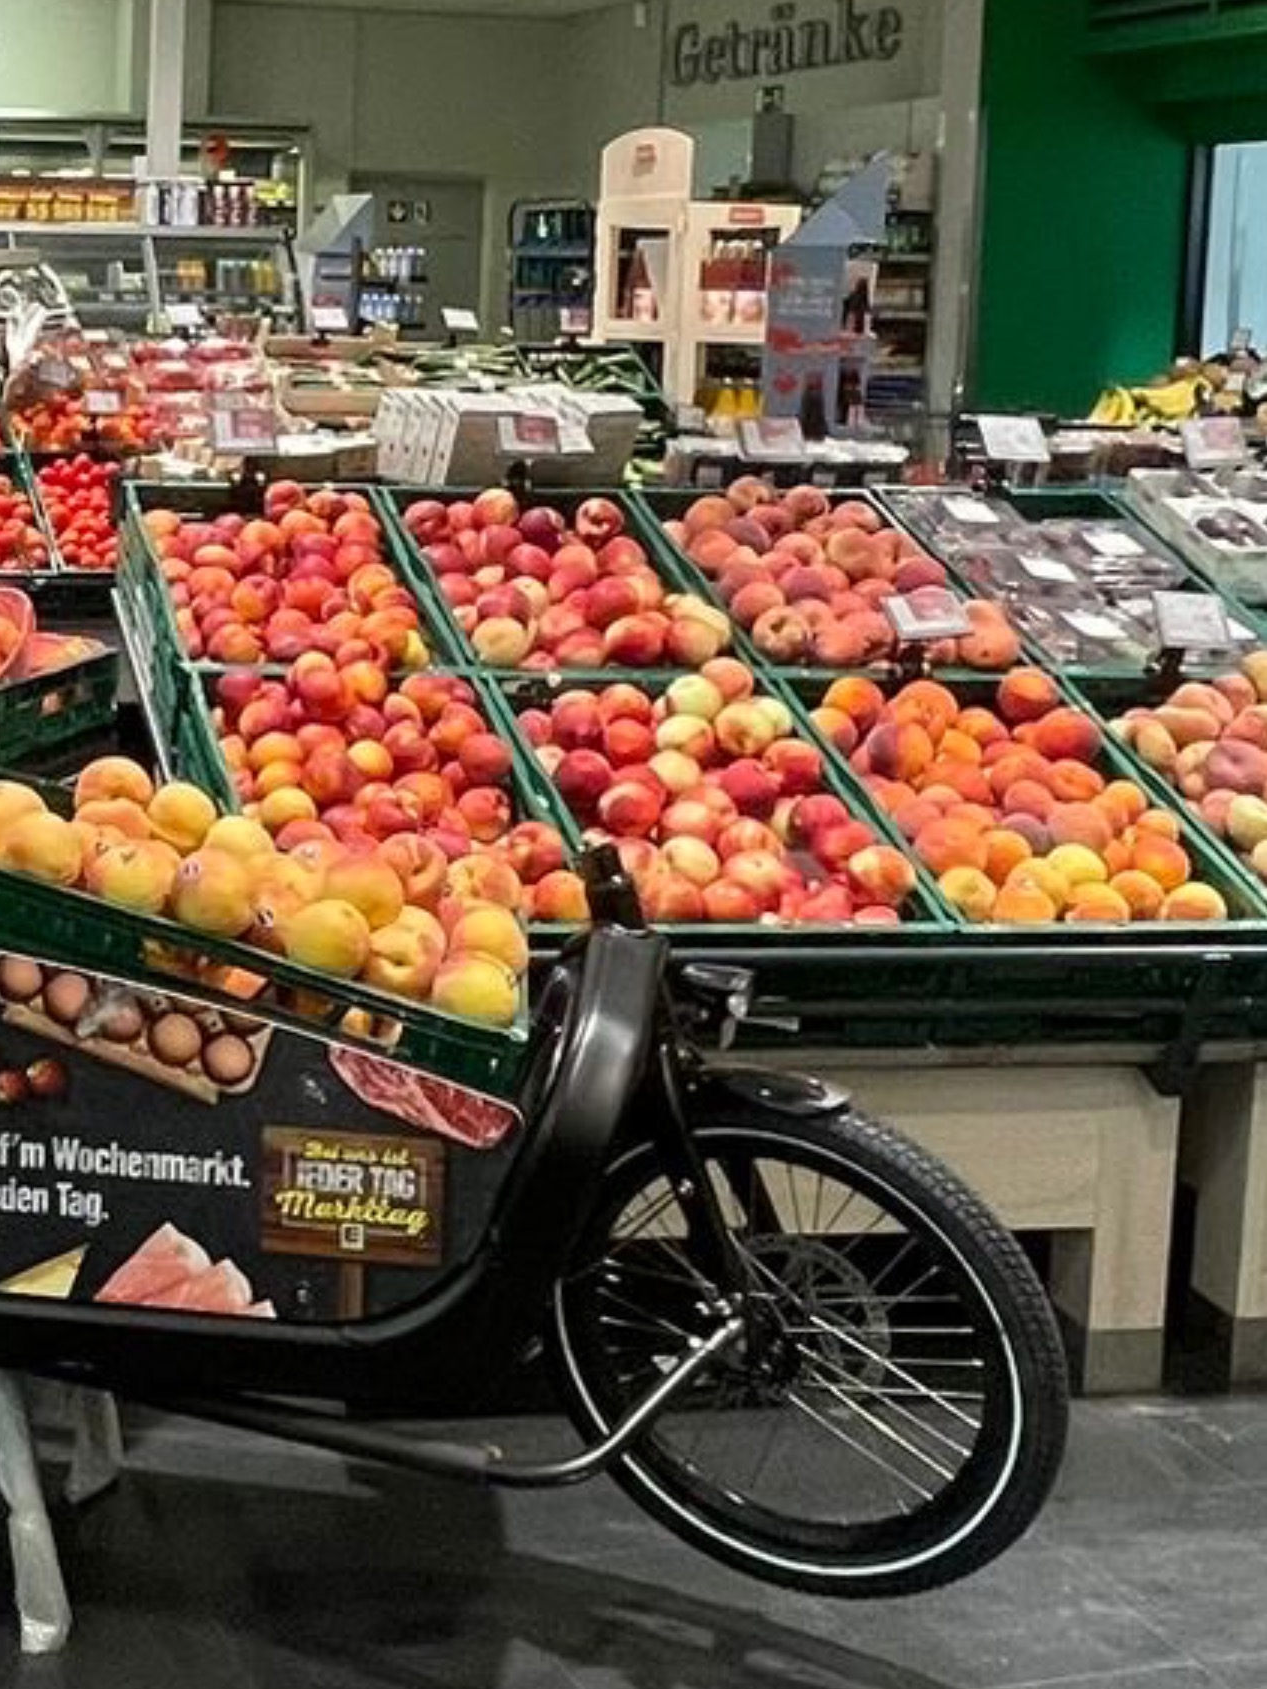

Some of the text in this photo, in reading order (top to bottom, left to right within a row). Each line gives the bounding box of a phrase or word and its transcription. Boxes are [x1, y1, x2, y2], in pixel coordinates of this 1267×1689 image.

[670, 0, 902, 86] Getränke
[51, 1135, 252, 1189] Wochenmarkt.
[55, 1181, 110, 1228] Tag.
[275, 1188, 429, 1237] Markttag
